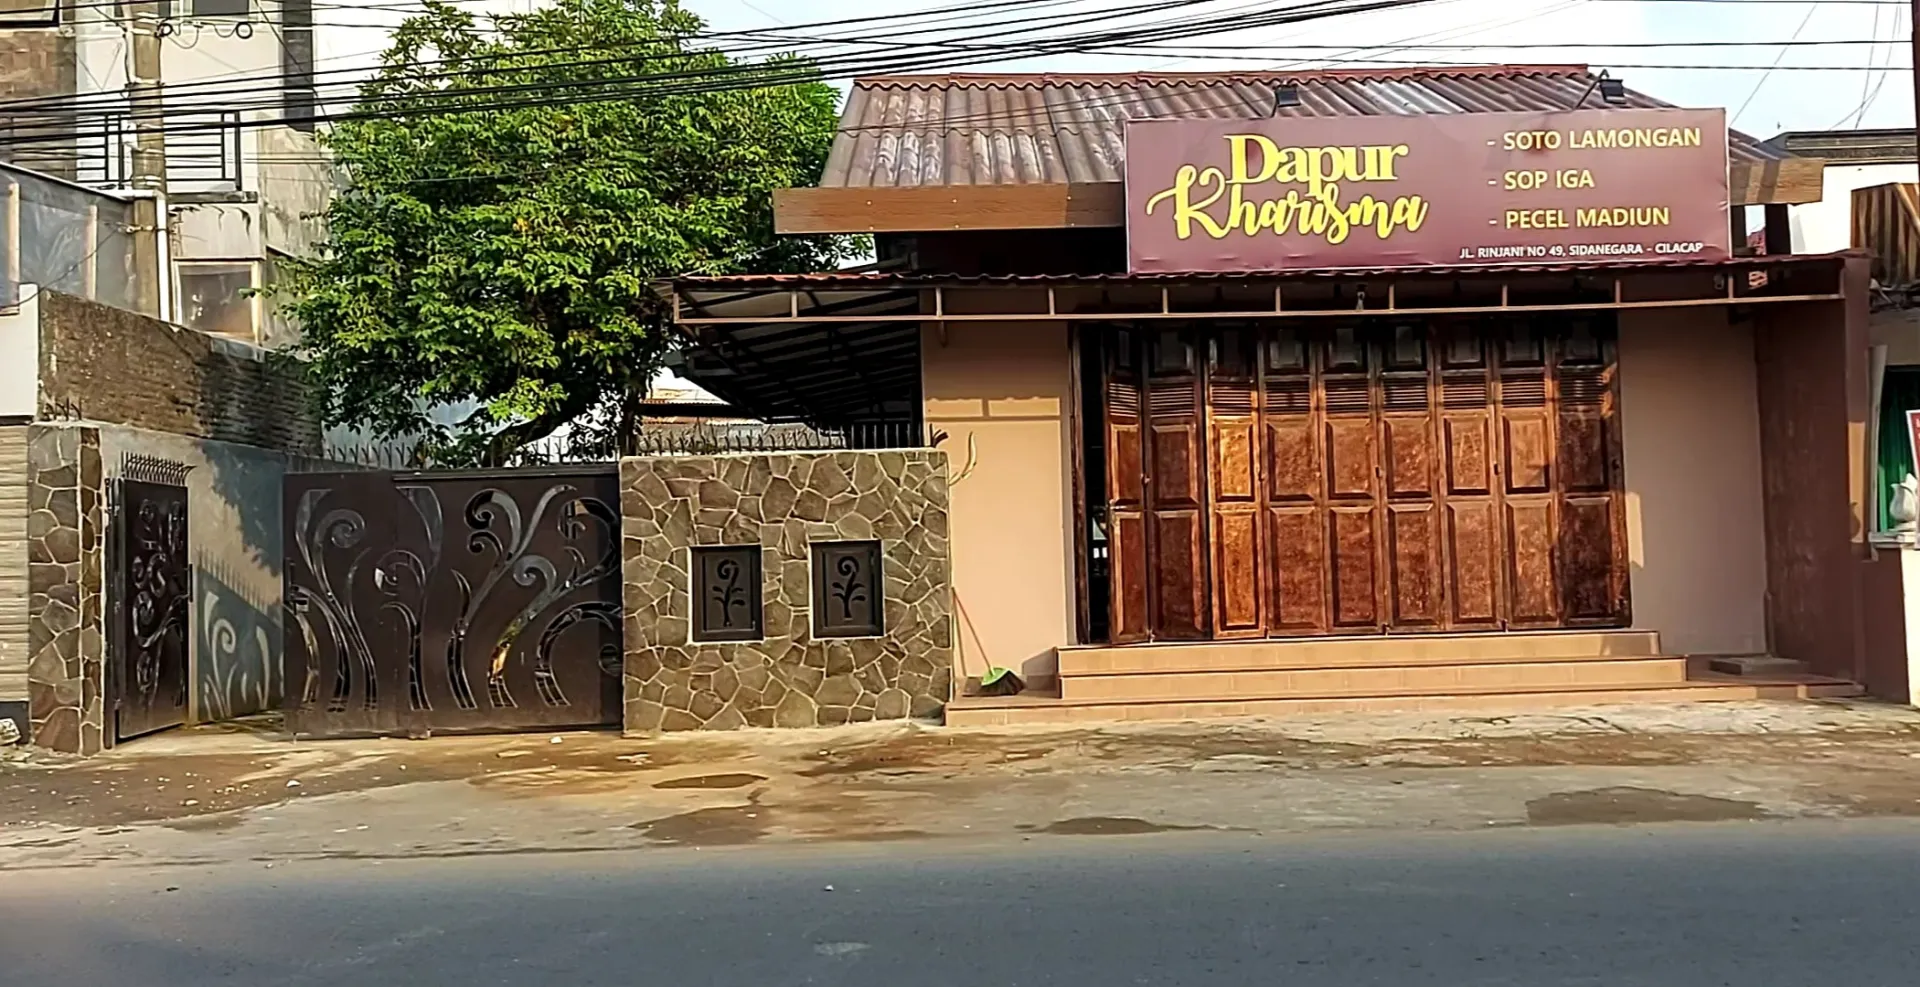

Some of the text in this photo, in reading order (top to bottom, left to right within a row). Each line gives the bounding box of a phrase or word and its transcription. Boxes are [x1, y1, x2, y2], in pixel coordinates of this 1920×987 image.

[1503, 131, 1562, 151] SOTO
[1569, 127, 1701, 149] LAMONGAN
[1223, 133, 1409, 200] Dapur
[1503, 170, 1548, 190] SOP
[1556, 170, 1595, 188] IGA
[1146, 165, 1429, 244] Kharisma
[1506, 209, 1569, 230] PECEL
[1576, 207, 1670, 227] MADIUN
[1478, 246, 1524, 259] RINJANI
[1527, 246, 1546, 258] NO
[1548, 245, 1567, 258] 49,
[1569, 244, 1643, 257] SIDANEGARA
[1655, 242, 1704, 255] CILACAP
